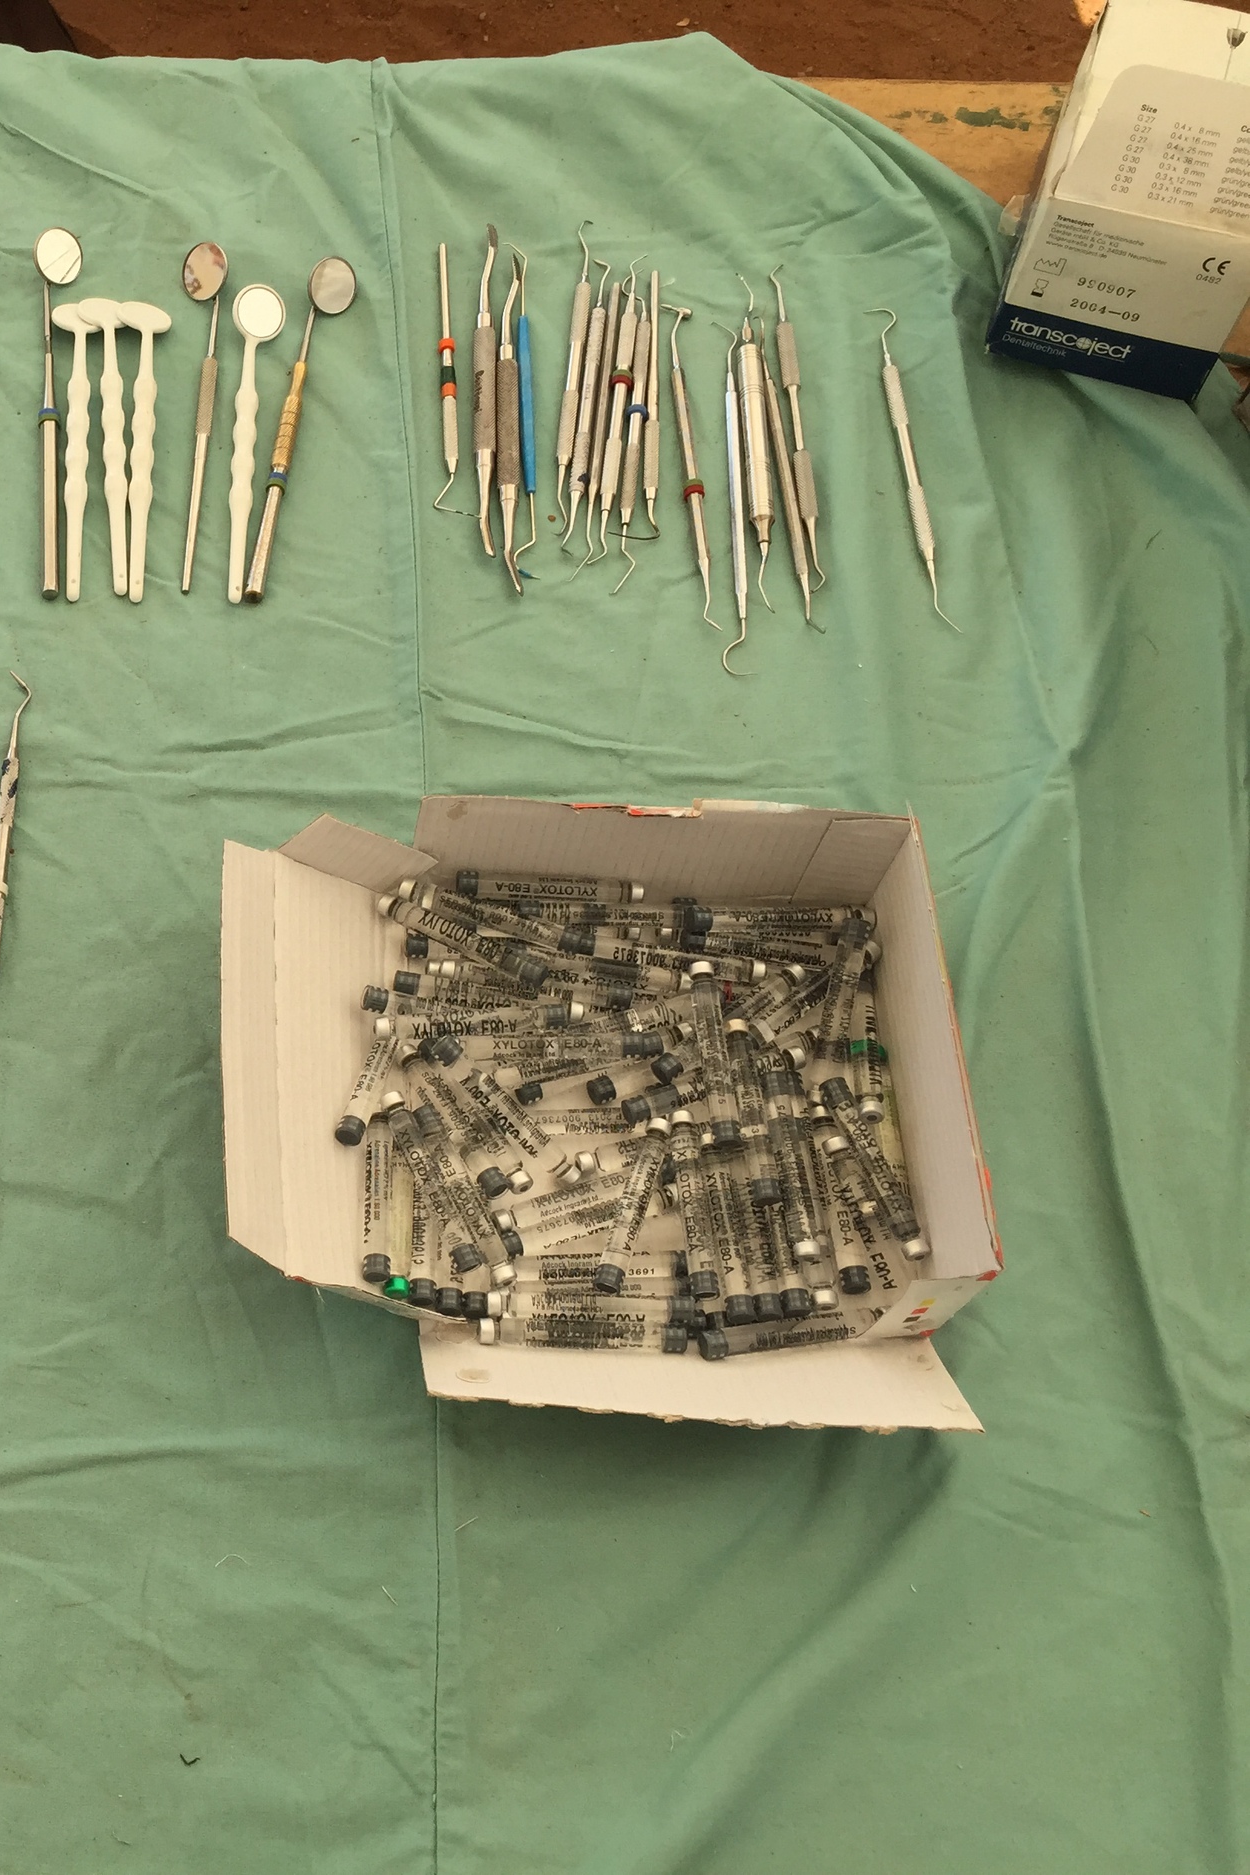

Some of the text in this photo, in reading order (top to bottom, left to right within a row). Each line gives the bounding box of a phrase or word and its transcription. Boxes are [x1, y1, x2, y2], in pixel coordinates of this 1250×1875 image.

[1140, 104, 1158, 114] Size
[1137, 114, 1156, 124] G 27
[1134, 124, 1152, 134] G 27
[1198, 127, 1205, 135] 8
[1205, 130, 1221, 138] mm
[1130, 134, 1148, 144] G 27
[1192, 136, 1201, 144] 16
[1202, 140, 1217, 148] mm
[1126, 144, 1144, 154] G 27
[1186, 146, 1197, 154] 25
[1198, 149, 1214, 157] mm
[1122, 154, 1141, 164] G 30
[1183, 156, 1193, 165] 38
[1194, 159, 1210, 168] mm
[1118, 164, 1137, 174] G 30
[1190, 170, 1206, 178] mm
[1114, 174, 1133, 184] G 30
[1177, 176, 1186, 185] 12
[1186, 179, 1202, 187] mm
[1110, 184, 1129, 194] G 30
[1173, 186, 1181, 194] 16
[1182, 190, 1198, 198] mm
[1167, 196, 1177, 204] 21
[1178, 199, 1194, 207] mm
[1002, 333, 1067, 358] Dentaltechnik
[495, 882, 598, 896] XYLOTOX E80-A
[493, 1039, 602, 1050] XYLOTOX E80-A
[364, 1042, 381, 1068] OTOX
[397, 1128, 431, 1186] XYLOTOX
[433, 1142, 456, 1178] E80-A
[684, 1216, 699, 1252] E80-A
[836, 1209, 856, 1248] E80-A
[718, 1237, 734, 1275] E80-A
